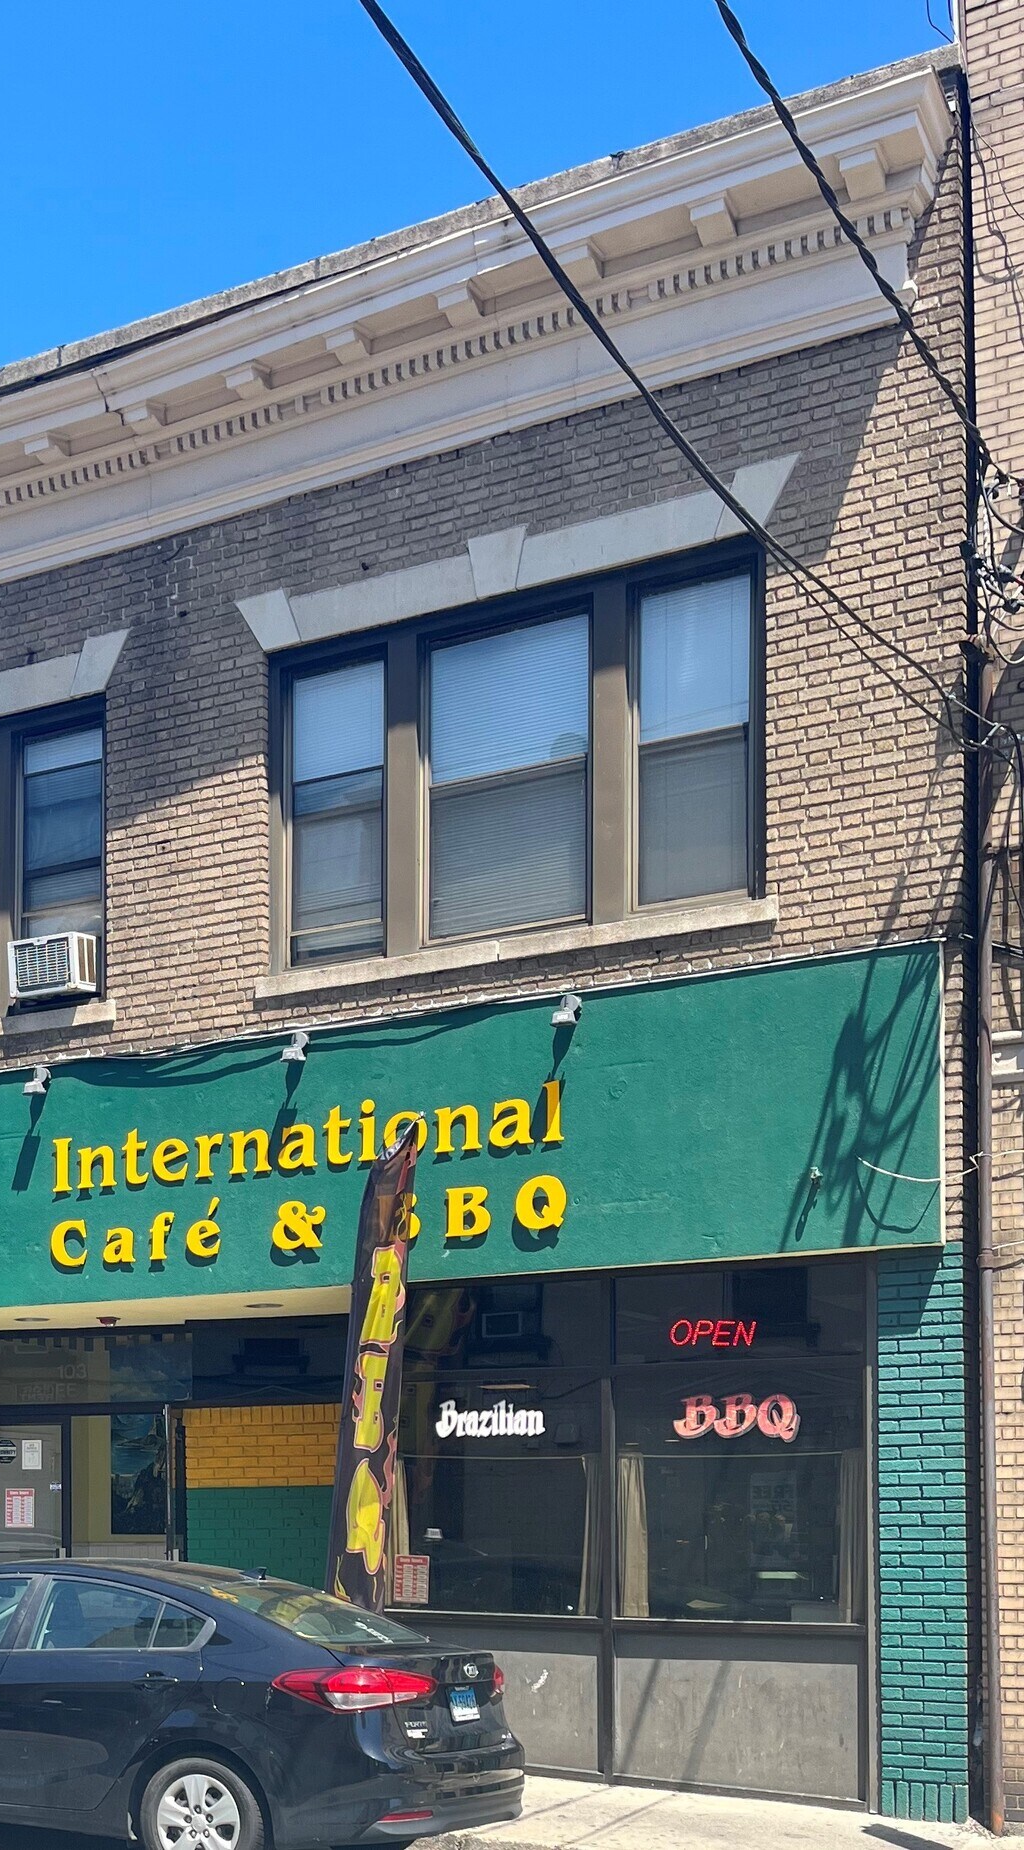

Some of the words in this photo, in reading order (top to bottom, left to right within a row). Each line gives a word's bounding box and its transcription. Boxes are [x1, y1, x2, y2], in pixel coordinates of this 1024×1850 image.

[52, 1079, 566, 1194] International
[50, 1196, 222, 1267] Café
[271, 1200, 327, 1249] &
[669, 1319, 757, 1347] OPEN
[57, 1363, 88, 1380] 103
[435, 1399, 546, 1438] Brazilian
[672, 1391, 801, 1443] BBQ
